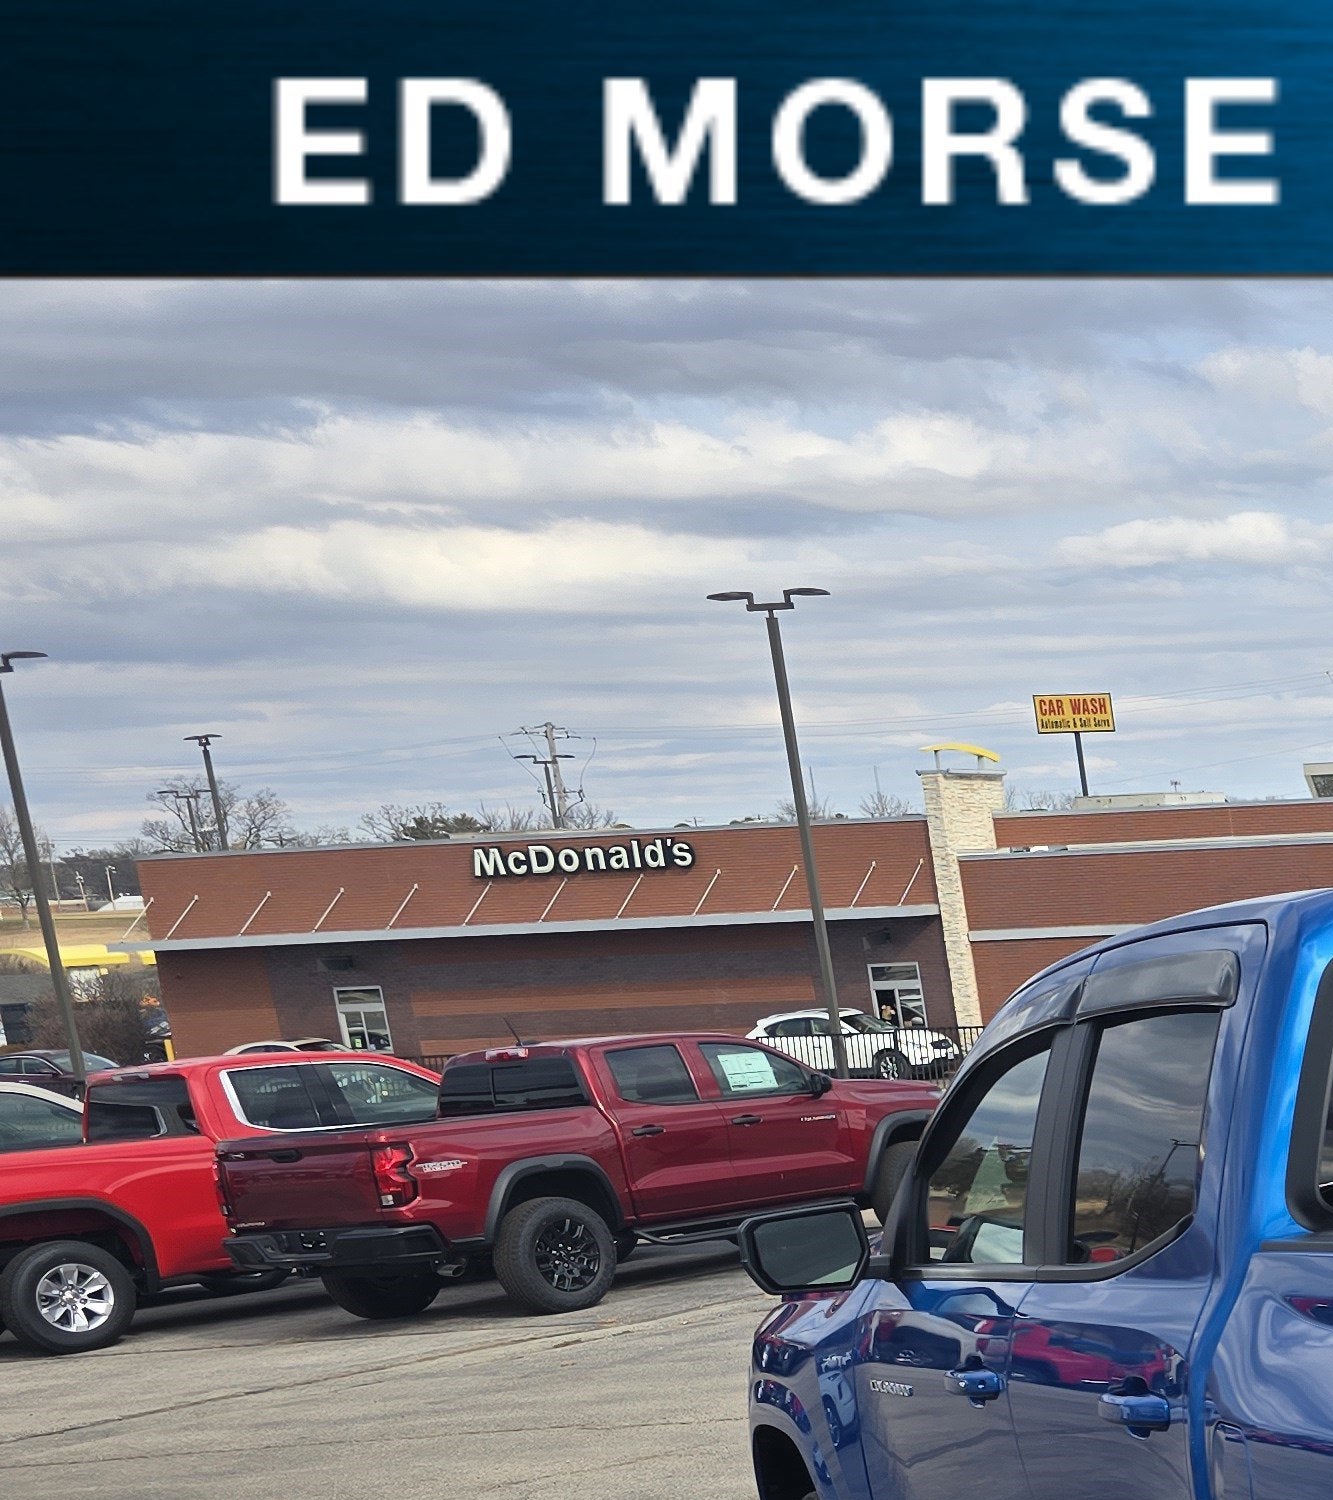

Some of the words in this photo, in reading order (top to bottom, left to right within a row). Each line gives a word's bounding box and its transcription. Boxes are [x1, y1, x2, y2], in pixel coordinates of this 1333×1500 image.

[1039, 698, 1065, 717] CAR
[1068, 697, 1108, 716] WASH
[473, 838, 693, 878] McDonald's
